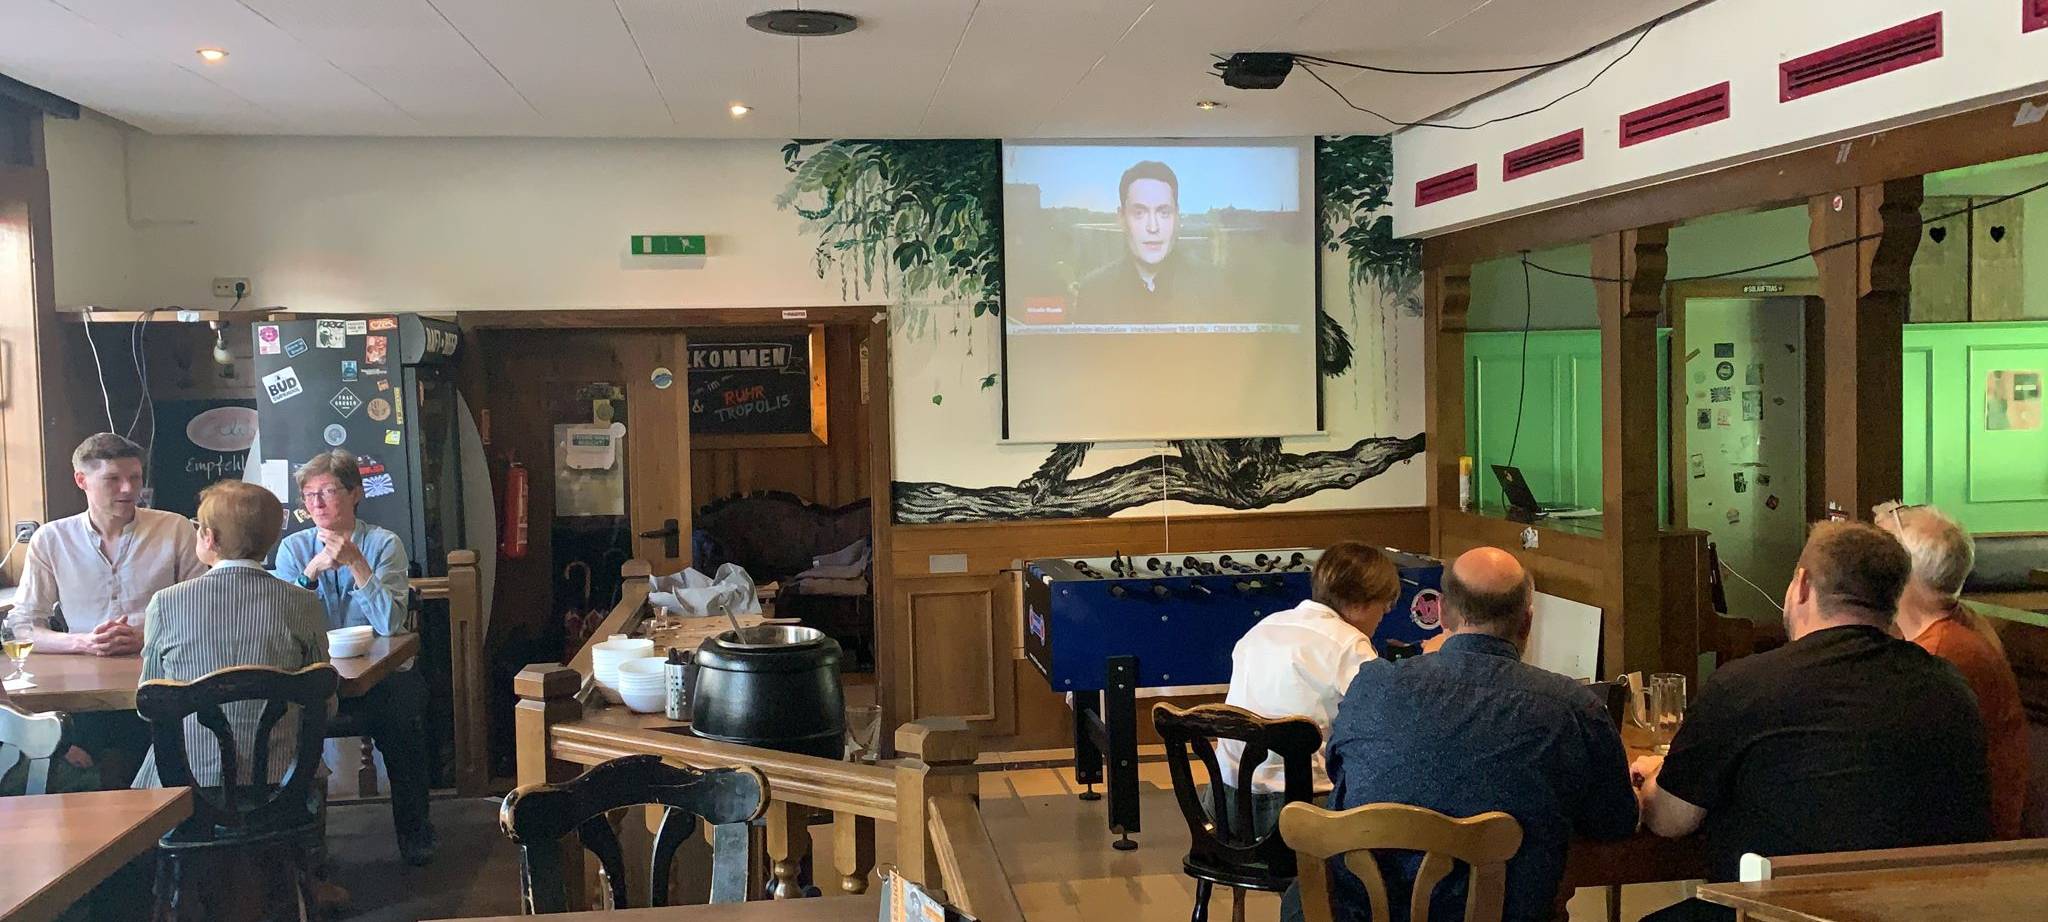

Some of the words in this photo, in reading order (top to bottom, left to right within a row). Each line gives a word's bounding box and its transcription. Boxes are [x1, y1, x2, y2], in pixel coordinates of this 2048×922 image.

[268, 377, 297, 397] BUD
[724, 385, 767, 405] RUHR
[714, 395, 791, 422] TROPOLIS
